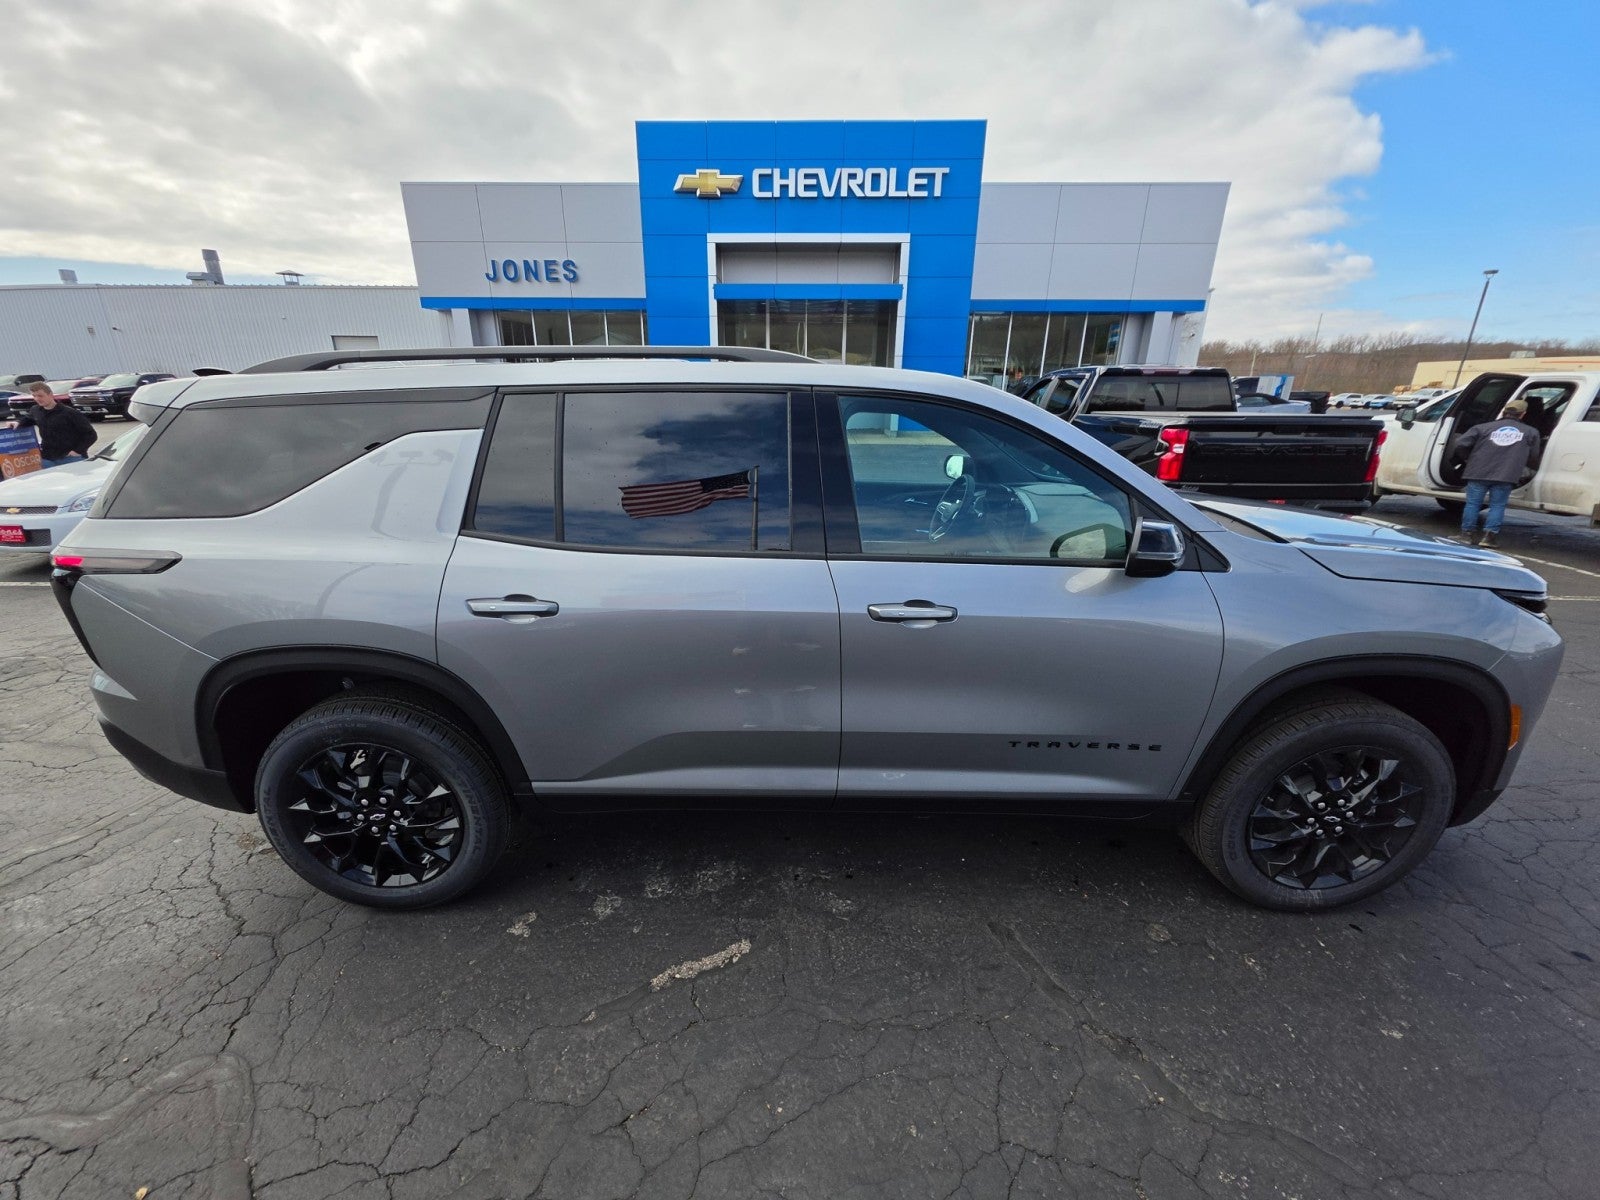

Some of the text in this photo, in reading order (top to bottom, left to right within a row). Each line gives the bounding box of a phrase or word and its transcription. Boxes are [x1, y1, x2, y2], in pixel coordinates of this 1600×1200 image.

[752, 167, 950, 197] CHEVROLET
[485, 259, 578, 282] JONES
[1007, 741, 1163, 752] TRAVERSE
